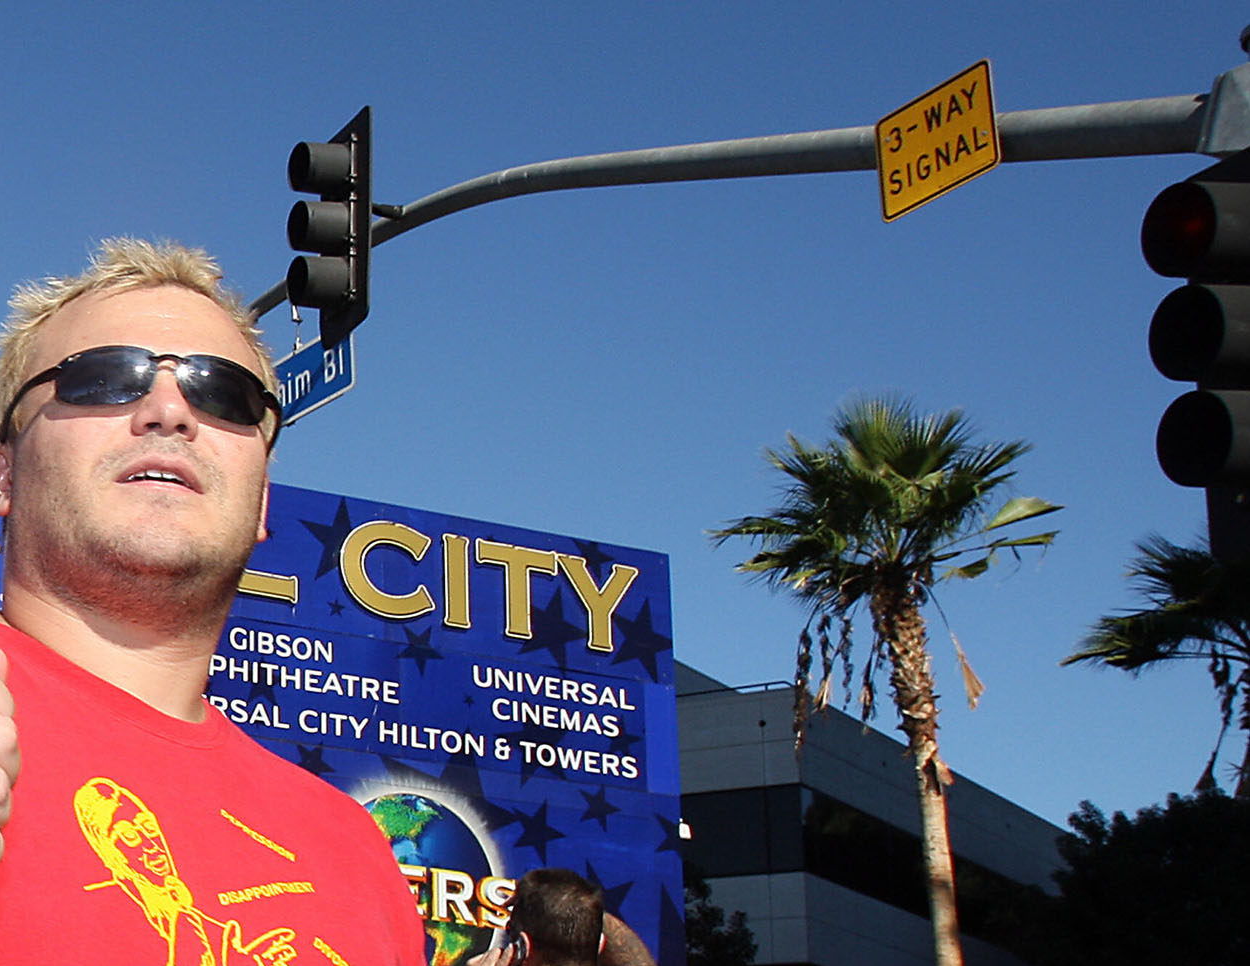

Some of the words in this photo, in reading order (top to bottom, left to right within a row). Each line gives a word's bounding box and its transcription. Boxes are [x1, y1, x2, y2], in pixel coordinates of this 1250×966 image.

[889, 81, 978, 153] 3-WAY
[889, 126, 988, 195] SIGNAL
[339, 521, 639, 652] CITY
[229, 627, 333, 664] GIBSON
[208, 654, 400, 705] PHITHEATRE
[472, 665, 636, 711] UNIVERSAL
[201, 694, 291, 730] RSAL
[299, 709, 369, 740] CITY
[378, 720, 486, 758] HILTON
[494, 738, 511, 761] &
[519, 741, 639, 780] TOWERS
[492, 698, 620, 738] CINEMAS
[217, 881, 316, 906] DISAPPOINTMENT
